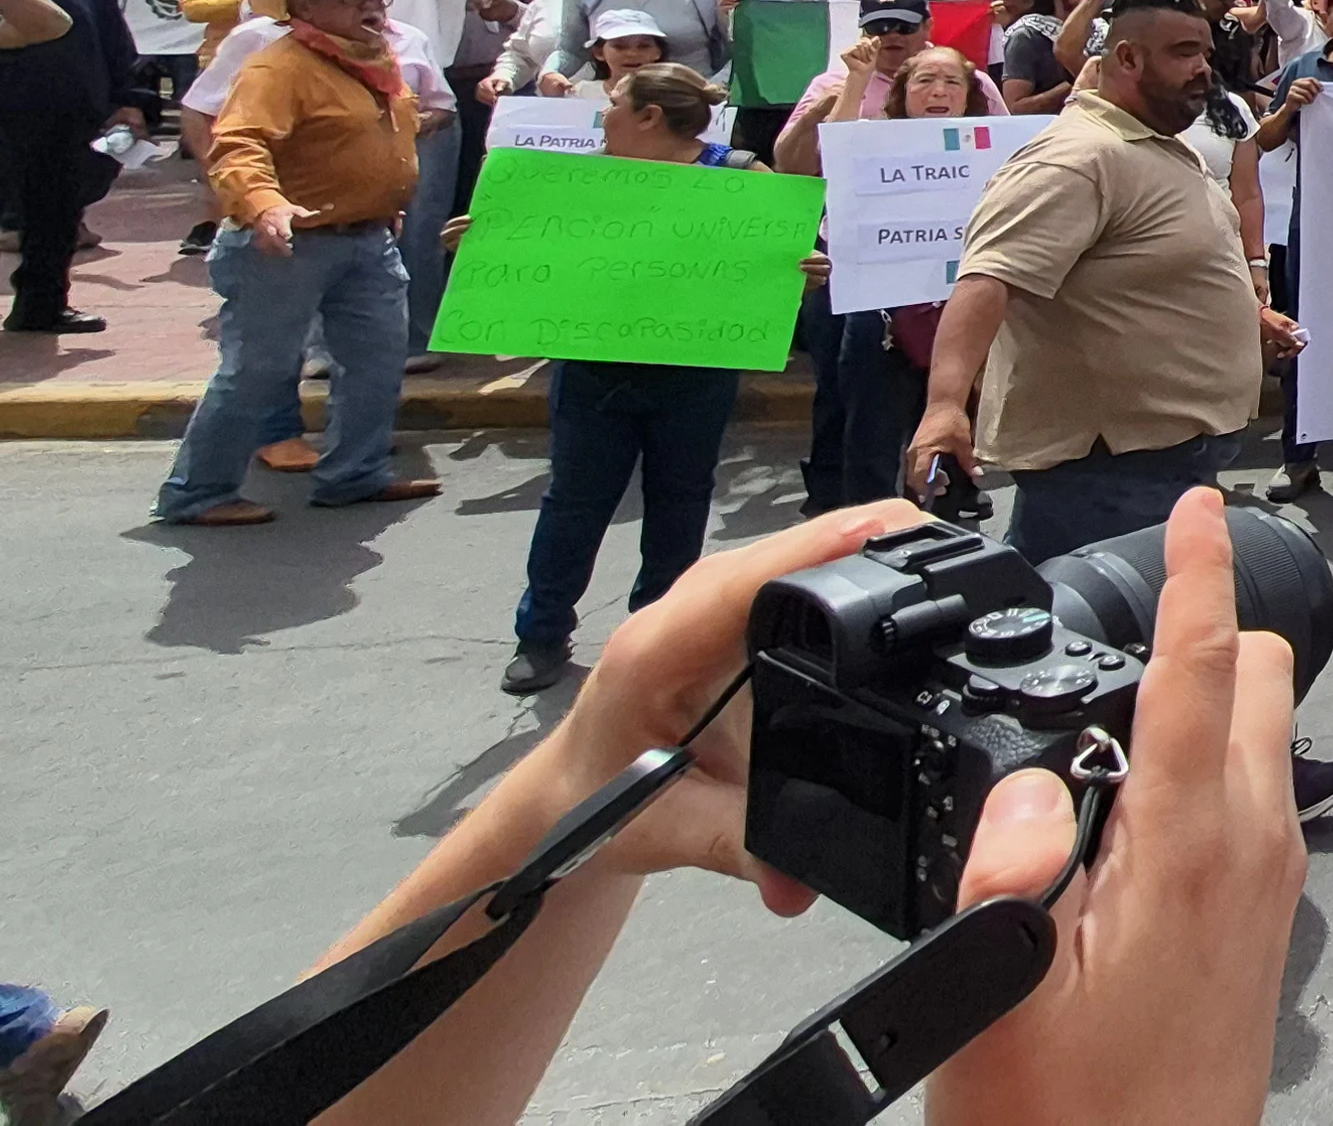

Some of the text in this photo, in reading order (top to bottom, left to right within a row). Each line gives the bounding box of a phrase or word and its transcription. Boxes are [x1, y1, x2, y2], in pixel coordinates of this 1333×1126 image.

[515, 134, 535, 147] LA
[540, 134, 596, 149] PATRIA
[880, 164, 970, 184] LA TRAIC
[878, 226, 967, 245] PATRIA S
